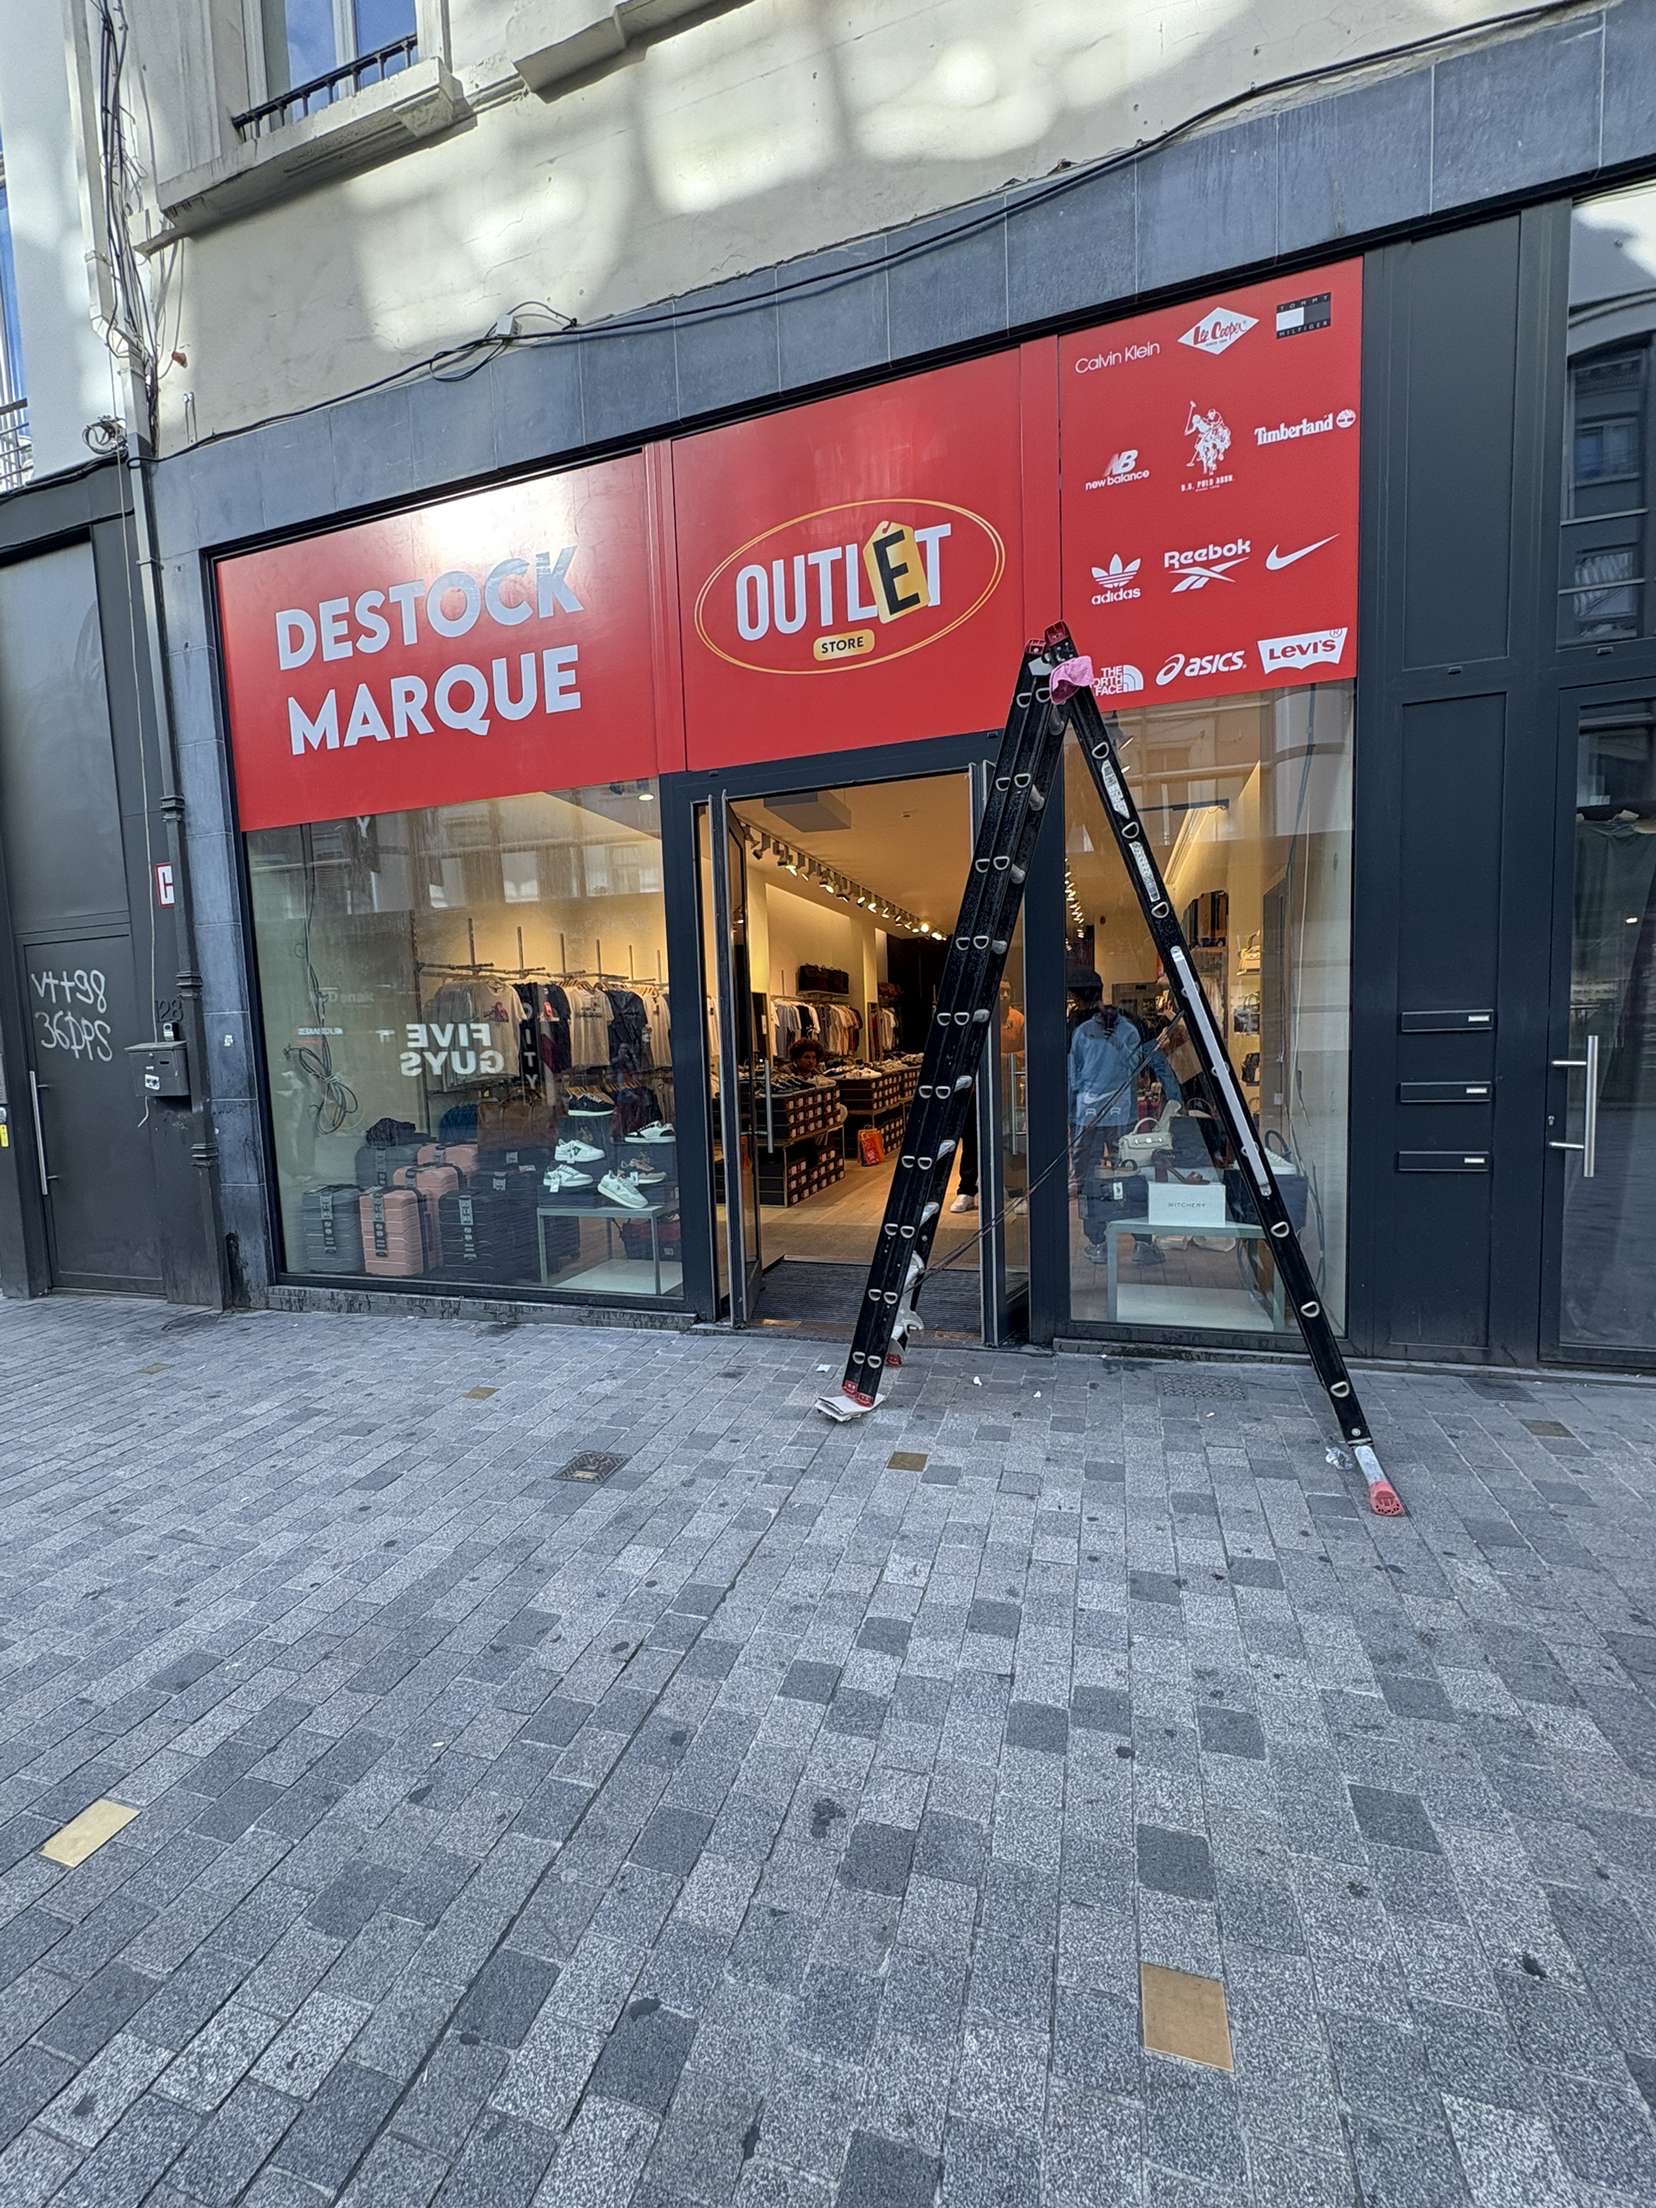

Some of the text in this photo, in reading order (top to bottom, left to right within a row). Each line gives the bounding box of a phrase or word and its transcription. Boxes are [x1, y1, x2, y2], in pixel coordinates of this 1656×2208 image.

[1279, 295, 1329, 310] TOMMY
[1278, 321, 1329, 337] HILFIGER
[1075, 341, 1160, 374] Calvin Klein
[1254, 413, 1334, 445] Timberland
[1085, 469, 1150, 491] new balance
[1164, 538, 1251, 569] Reebok
[735, 523, 951, 641] OUTLET
[1091, 587, 1141, 605] adidas
[275, 545, 584, 671] DESTOCK
[821, 636, 864, 654] STORE
[1091, 674, 1123, 689] ORTH
[1101, 665, 1123, 678] THE
[288, 644, 581, 755] MARQUE
[1095, 684, 1123, 697] FACE
